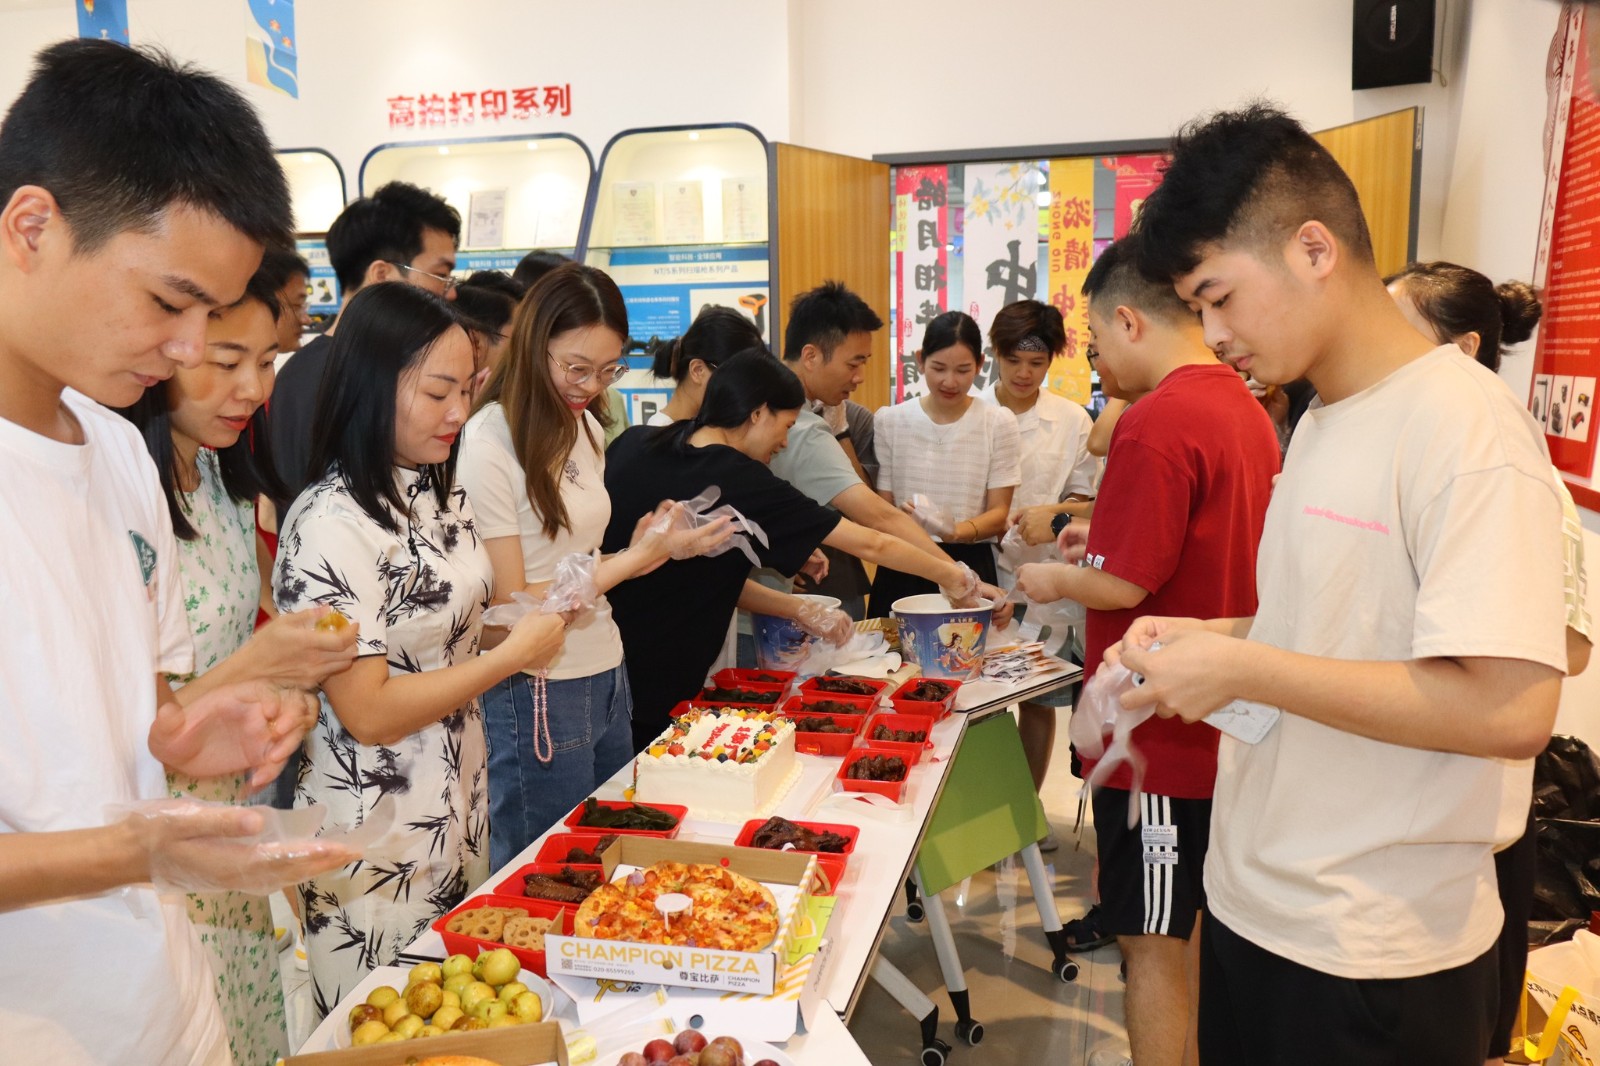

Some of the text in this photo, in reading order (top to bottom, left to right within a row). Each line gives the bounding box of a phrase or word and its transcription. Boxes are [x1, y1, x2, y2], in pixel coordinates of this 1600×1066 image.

[560, 941, 760, 975] CHAMPION PIZZA
[679, 971, 720, 984] 尊宝比萨
[727, 975, 761, 983] CHAMPION
